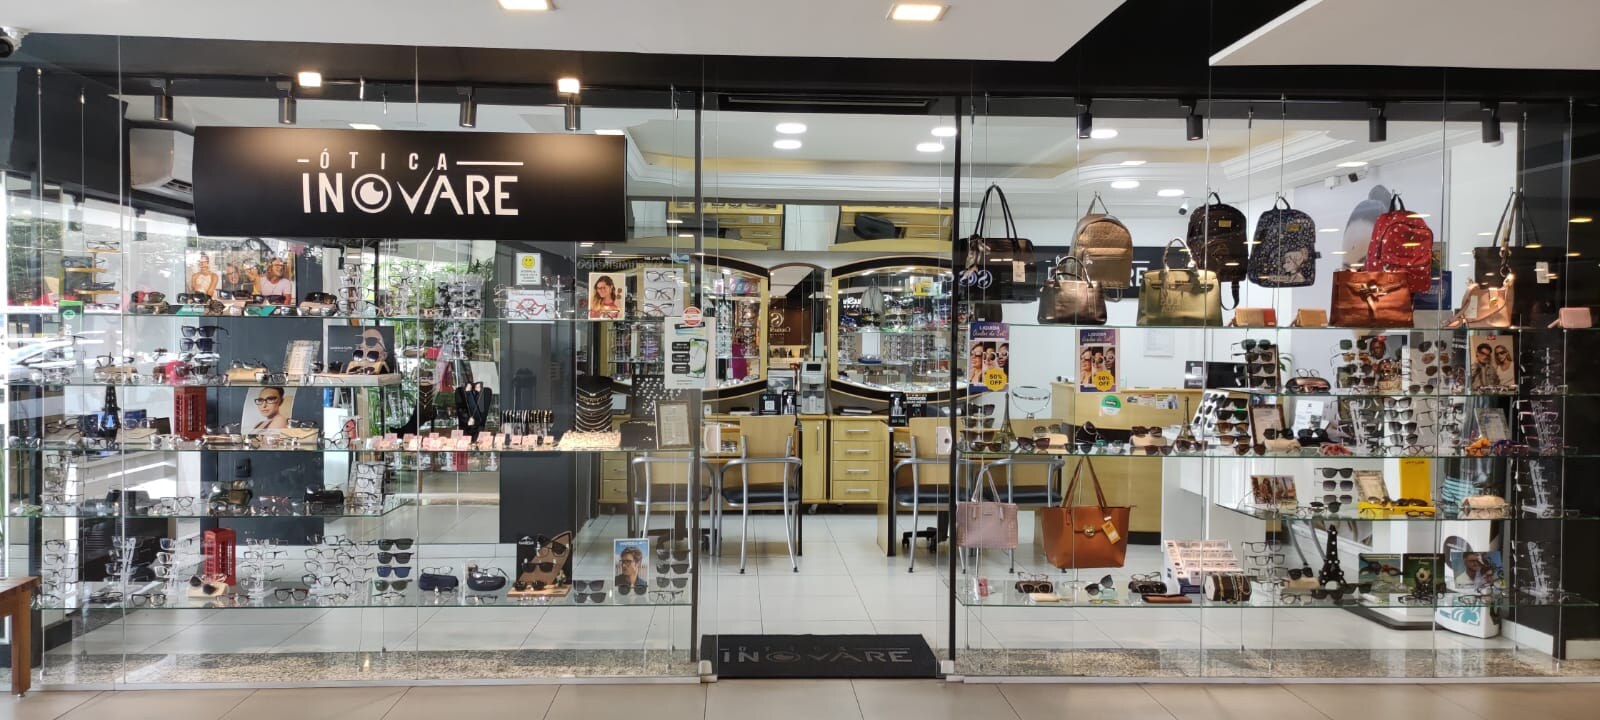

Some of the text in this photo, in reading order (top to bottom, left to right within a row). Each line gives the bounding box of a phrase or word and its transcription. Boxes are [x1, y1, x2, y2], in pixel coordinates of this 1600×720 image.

[320, 148, 448, 171] ÓTICA
[302, 167, 519, 216] INOVARE
[723, 649, 913, 663] INOVARE
